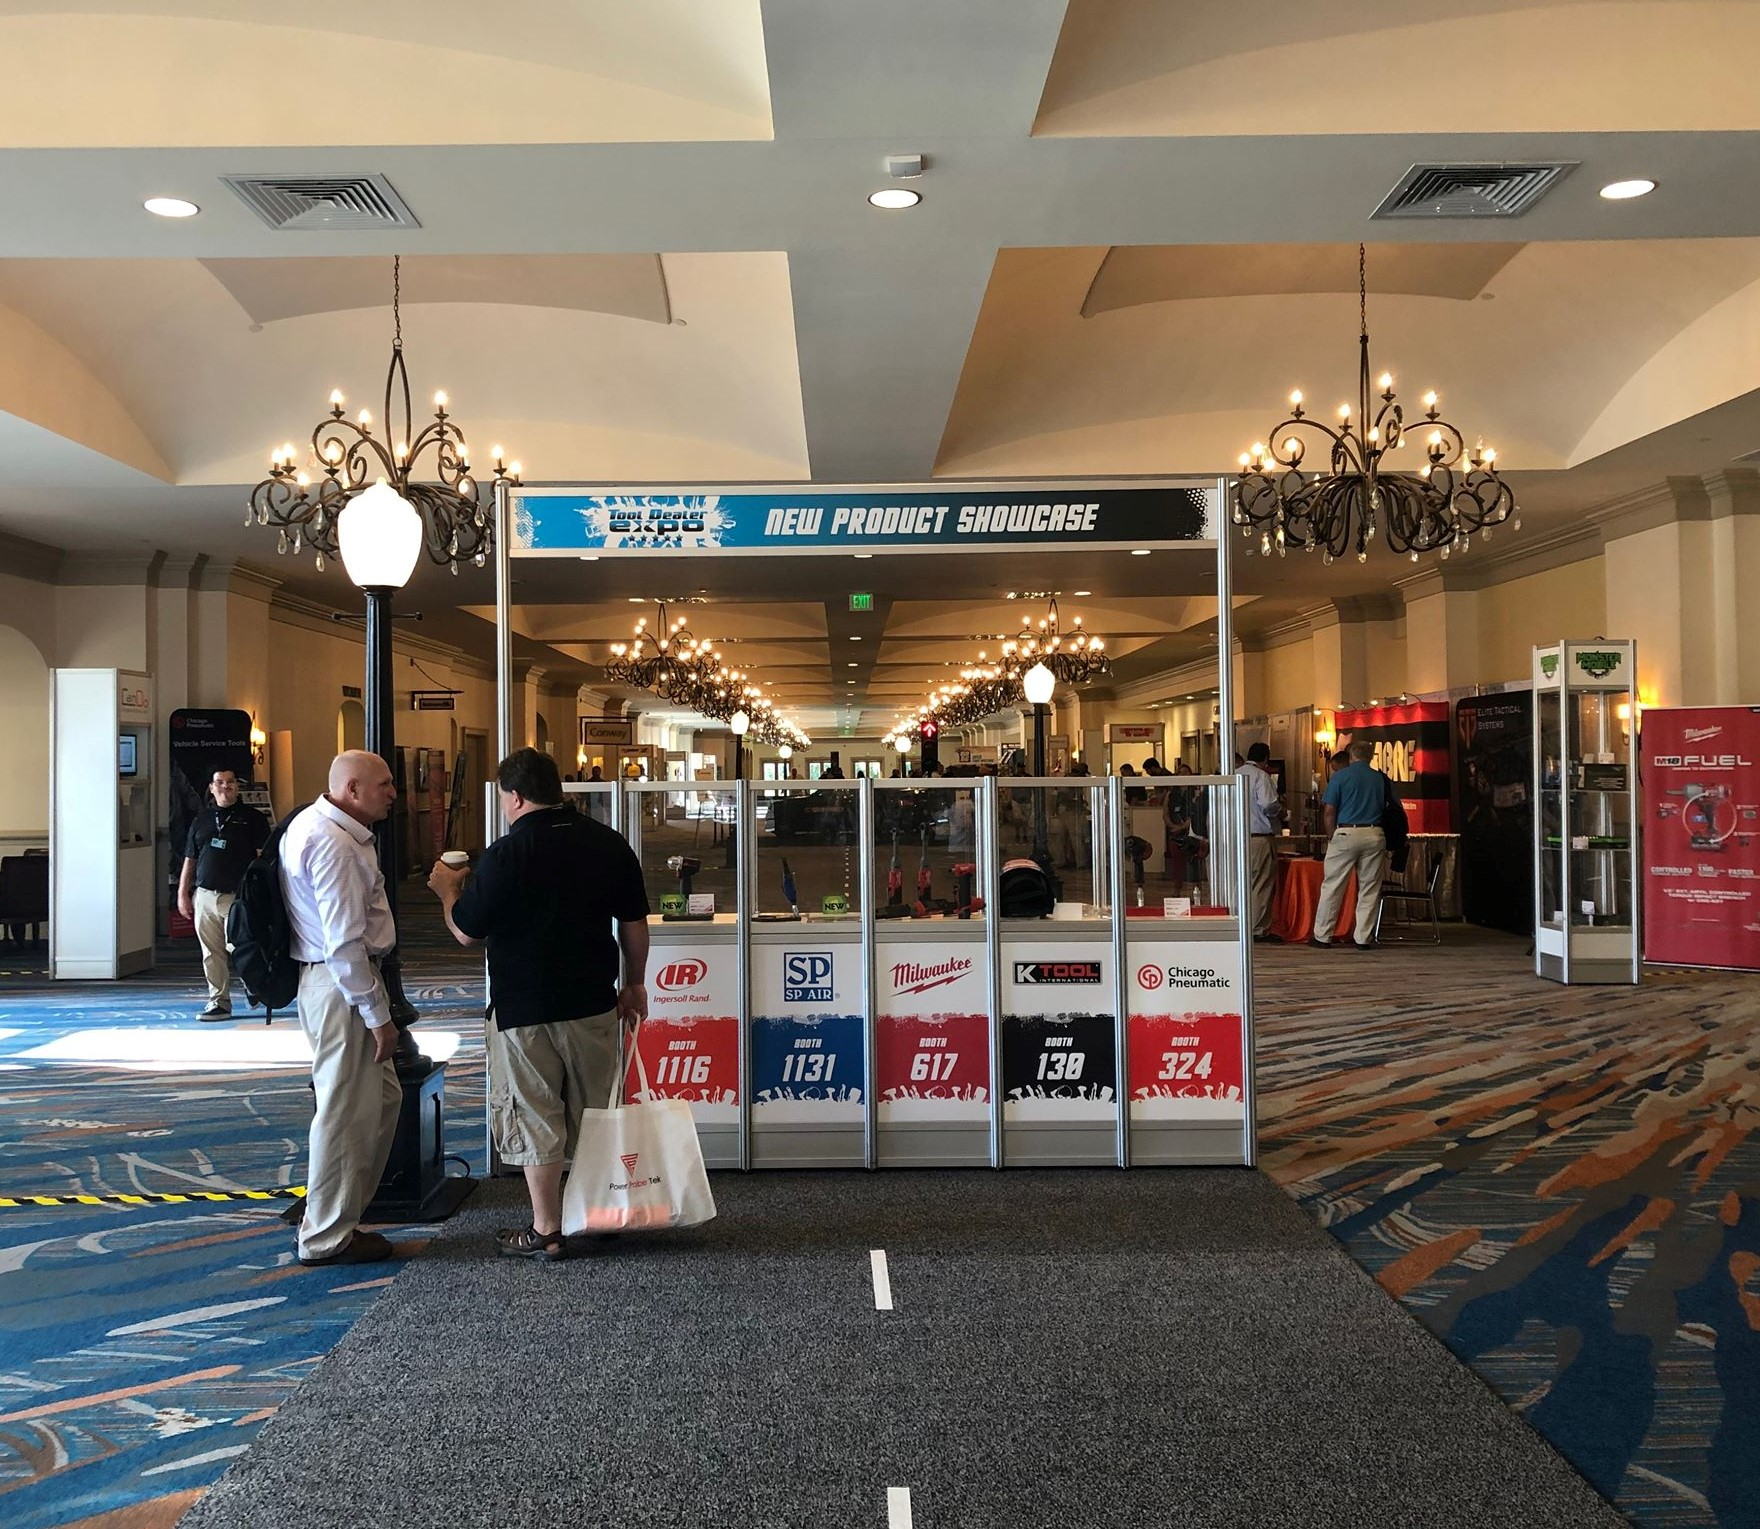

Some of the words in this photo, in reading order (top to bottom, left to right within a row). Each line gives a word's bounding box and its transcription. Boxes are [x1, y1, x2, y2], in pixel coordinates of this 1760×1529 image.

[608, 509, 642, 520] Tool
[648, 509, 707, 520] Dealer
[764, 508, 824, 536] NEW
[830, 506, 950, 535] PRODUCT
[957, 503, 1100, 533] SHOWCASE
[609, 520, 704, 536] expo
[852, 595, 870, 609] EXIT
[1478, 708, 1493, 717] ELITE
[1495, 705, 1522, 716] TACTICAL
[1478, 720, 1504, 730] SYSTEMS
[589, 727, 627, 740] Conway
[1684, 755, 1751, 766] FUEL
[662, 901, 683, 910] NEW
[824, 902, 845, 911] NEW
[664, 964, 698, 985] IR
[787, 957, 830, 985] SP
[888, 957, 972, 988] Milwaukee
[1017, 965, 1037, 982] K
[1040, 965, 1098, 977] TOOL
[1168, 967, 1215, 979] Chicago
[1169, 978, 1230, 988] Pneumatic
[653, 994, 687, 1004] Ingersoll
[689, 994, 709, 1003] Rand
[786, 989, 802, 1000] SP
[808, 989, 831, 1000] AIR
[668, 1040, 697, 1051] BOOTH
[794, 1038, 822, 1049] BOOTH
[919, 1037, 948, 1048] BOOTH
[1044, 1037, 1073, 1047] BOOTH
[1171, 1036, 1199, 1047] BOOTH
[656, 1055, 712, 1084] 1116
[782, 1054, 836, 1082] 1131
[910, 1053, 959, 1081] 617
[1036, 1052, 1085, 1081] 130
[1158, 1052, 1213, 1080] 324
[649, 1176, 661, 1185] Tek
